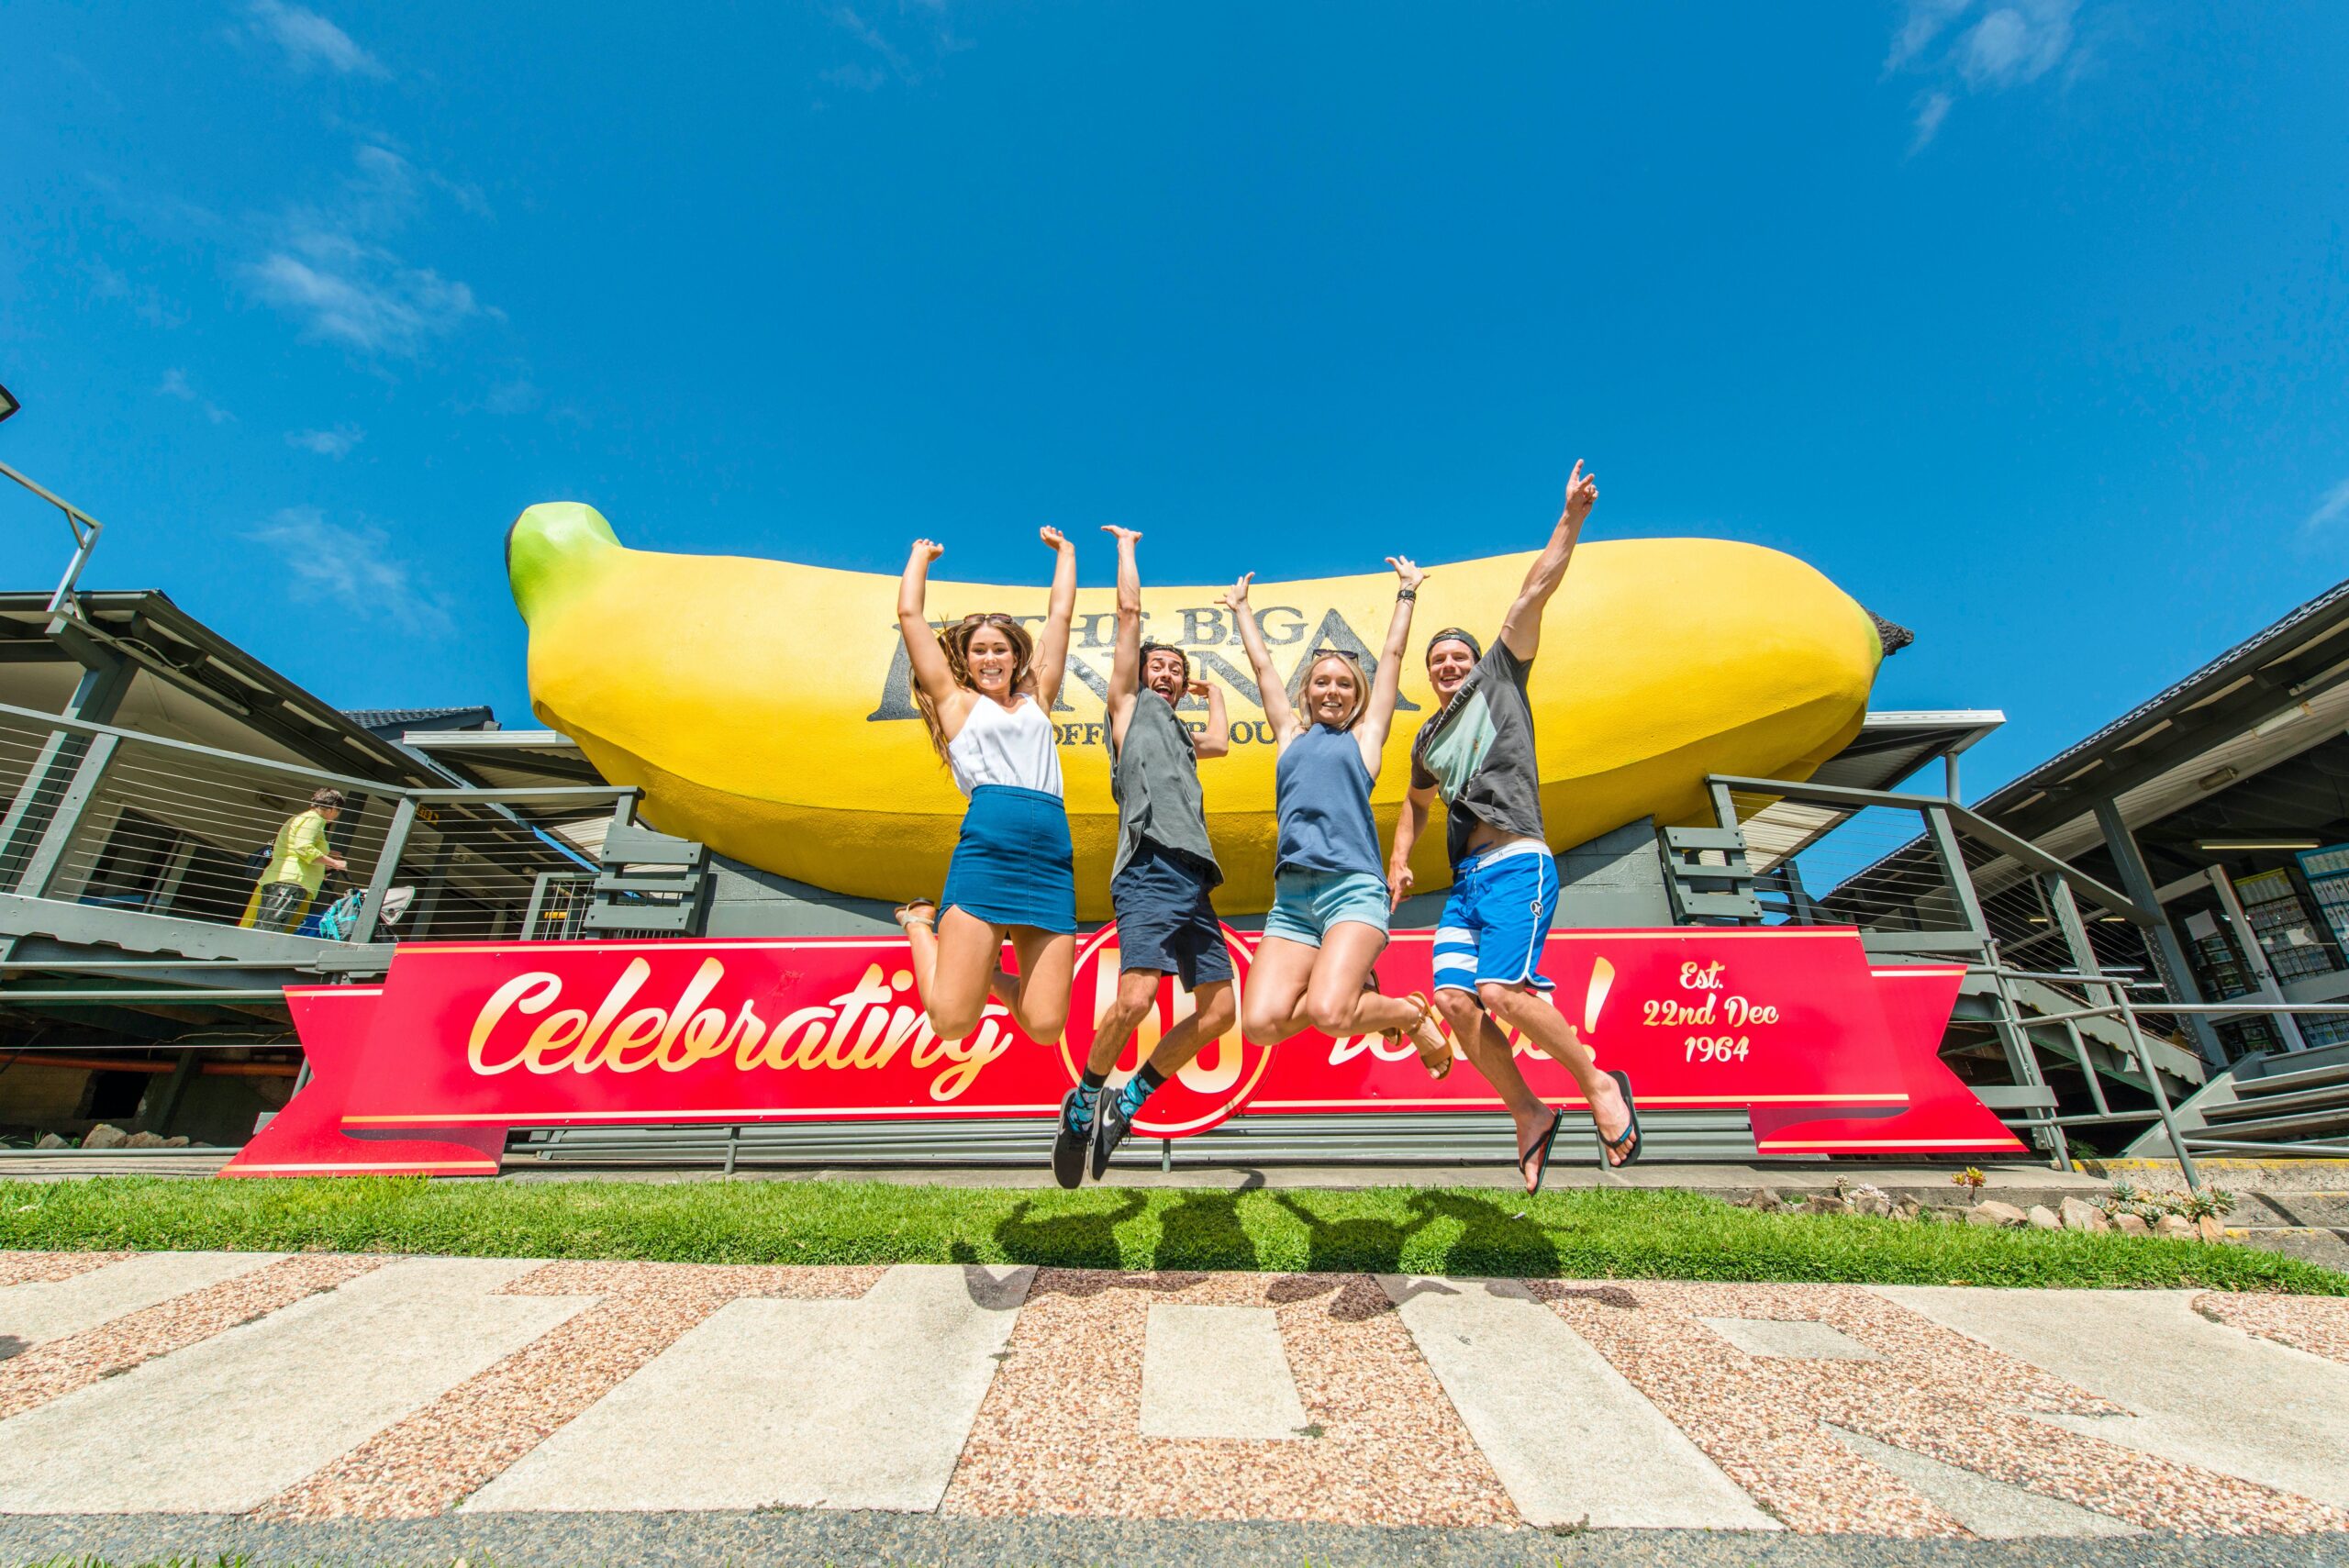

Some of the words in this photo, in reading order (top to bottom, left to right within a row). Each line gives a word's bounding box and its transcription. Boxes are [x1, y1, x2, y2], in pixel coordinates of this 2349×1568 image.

[1174, 606, 1308, 646] BIG
[1679, 960, 1725, 989] Est.
[1642, 992, 1717, 1027] 22nd
[1723, 995, 1779, 1028] Dec
[468, 956, 1014, 1101] Celebrating
[1684, 1035, 1750, 1063] 1964
